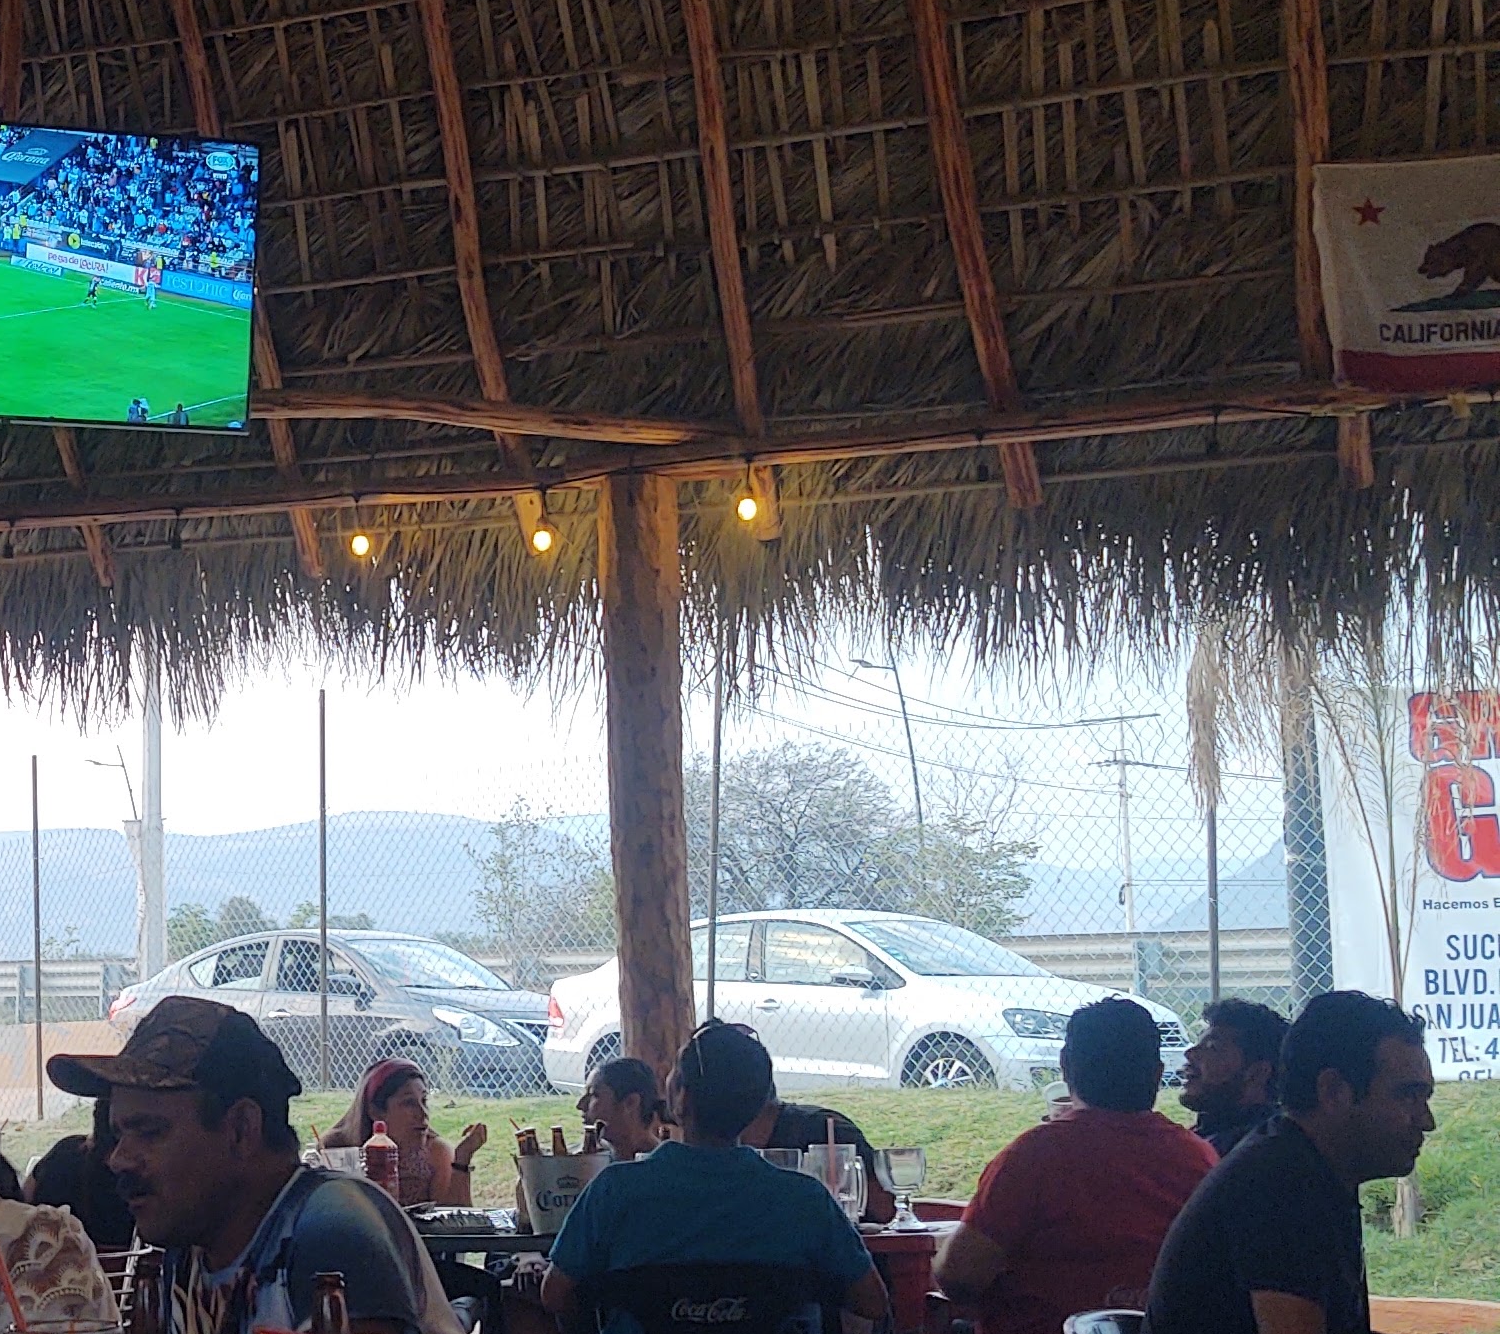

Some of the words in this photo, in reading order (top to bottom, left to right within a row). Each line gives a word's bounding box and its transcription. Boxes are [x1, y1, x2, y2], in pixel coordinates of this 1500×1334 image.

[1379, 320, 1500, 343] CALIFORNIA
[1423, 899, 1489, 910] Hacemos
[1446, 933, 1500, 961] SUC
[1412, 1003, 1451, 1030] SAN
[1438, 1036, 1480, 1063] TEL:
